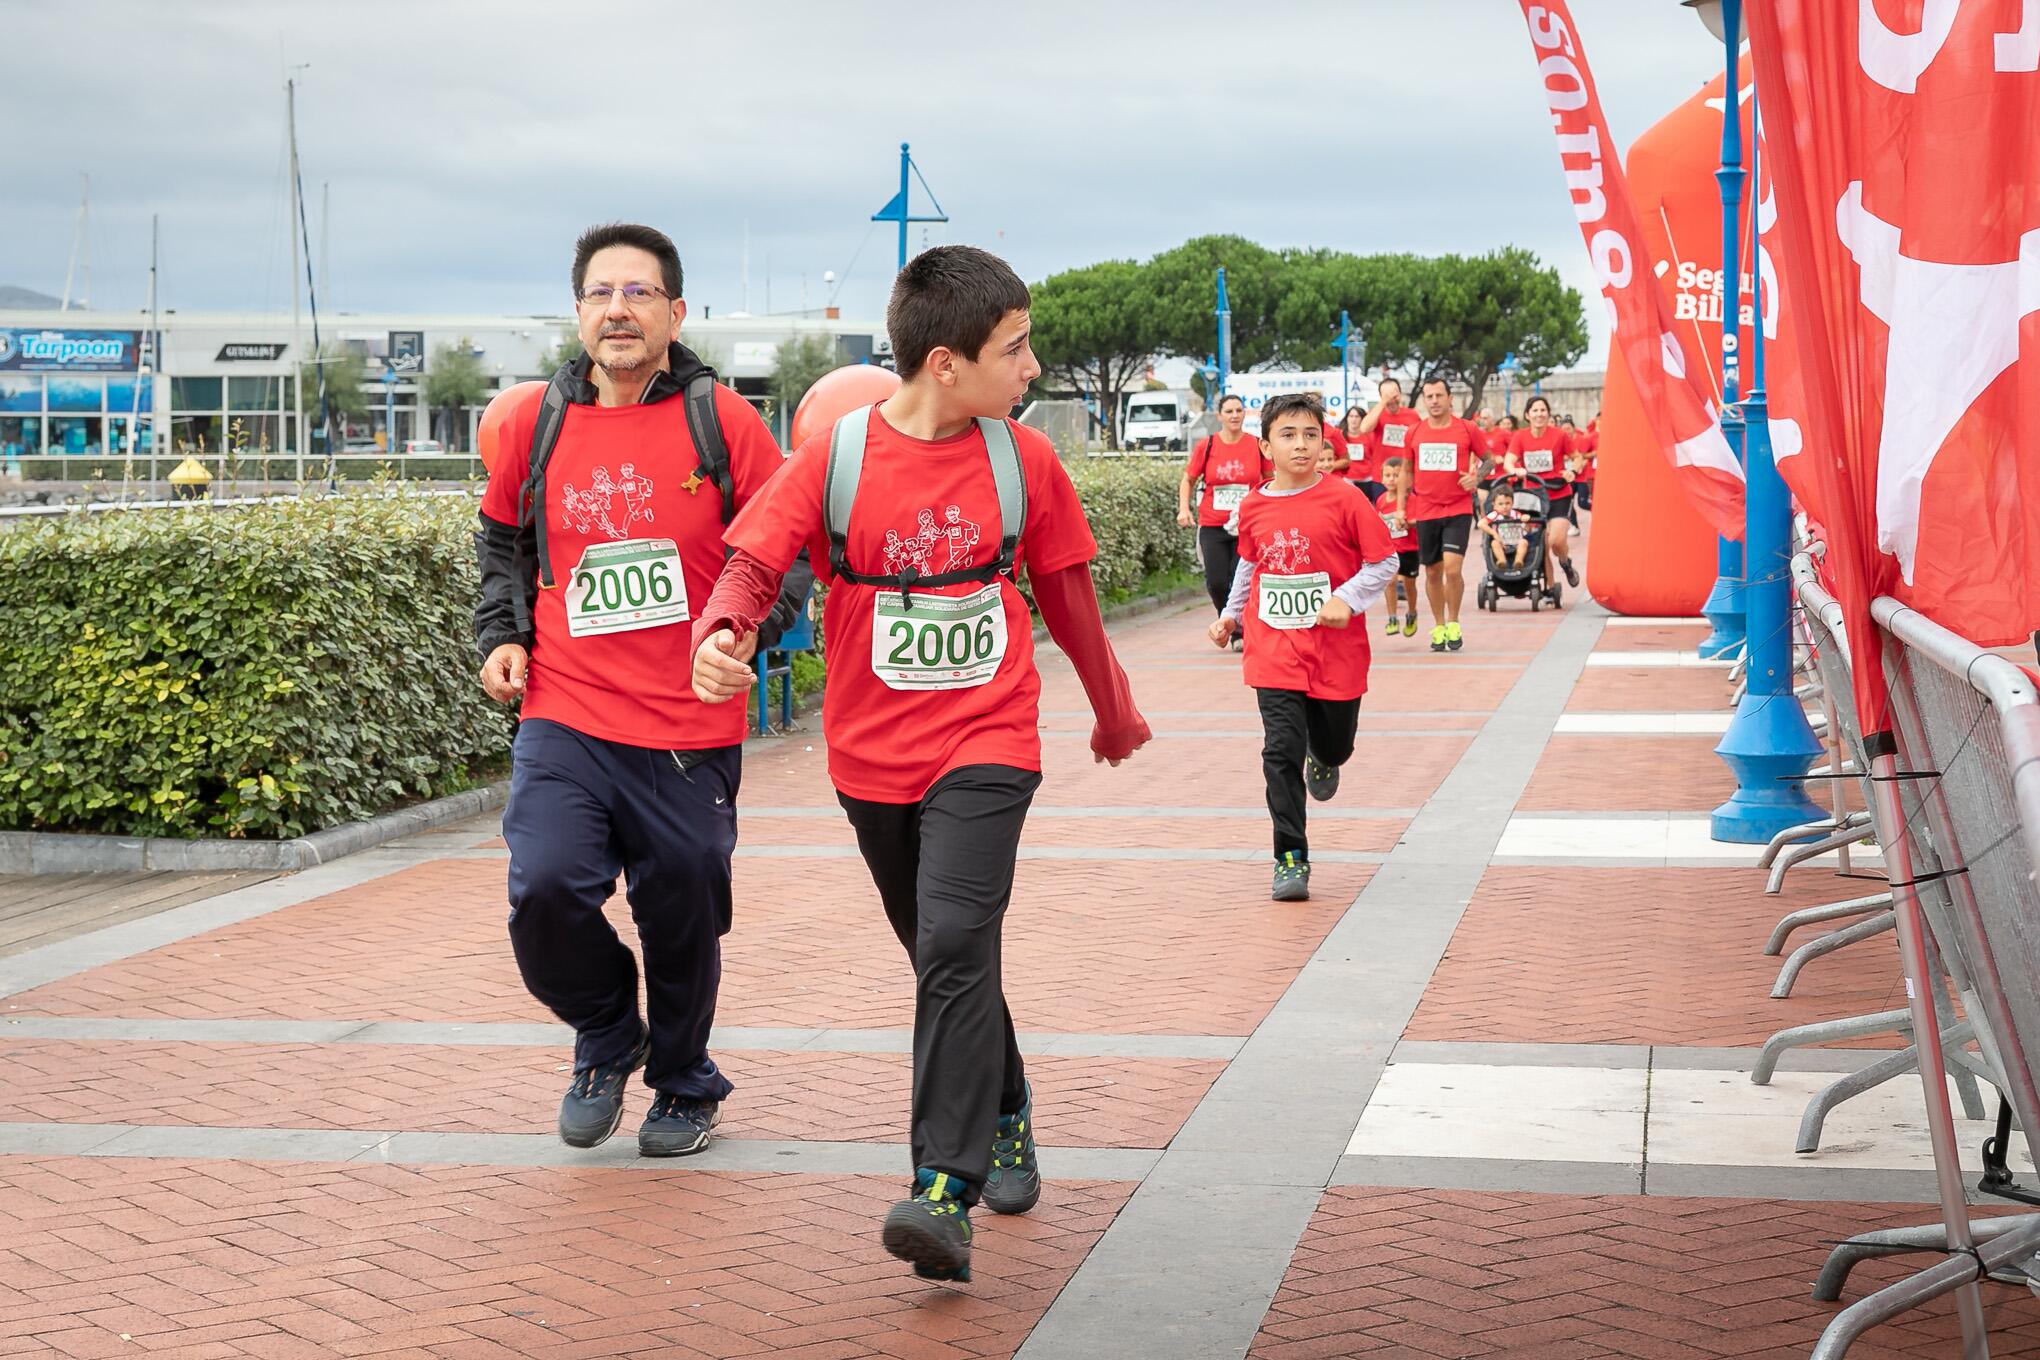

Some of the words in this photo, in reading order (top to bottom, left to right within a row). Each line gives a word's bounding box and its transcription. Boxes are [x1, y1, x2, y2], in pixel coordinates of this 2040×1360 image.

[20, 334, 123, 363] Tarpoon
[1423, 450, 1453, 465] 2025
[577, 562, 673, 612] 2006
[1267, 589, 1325, 616] 2006
[888, 615, 993, 666] 2006
